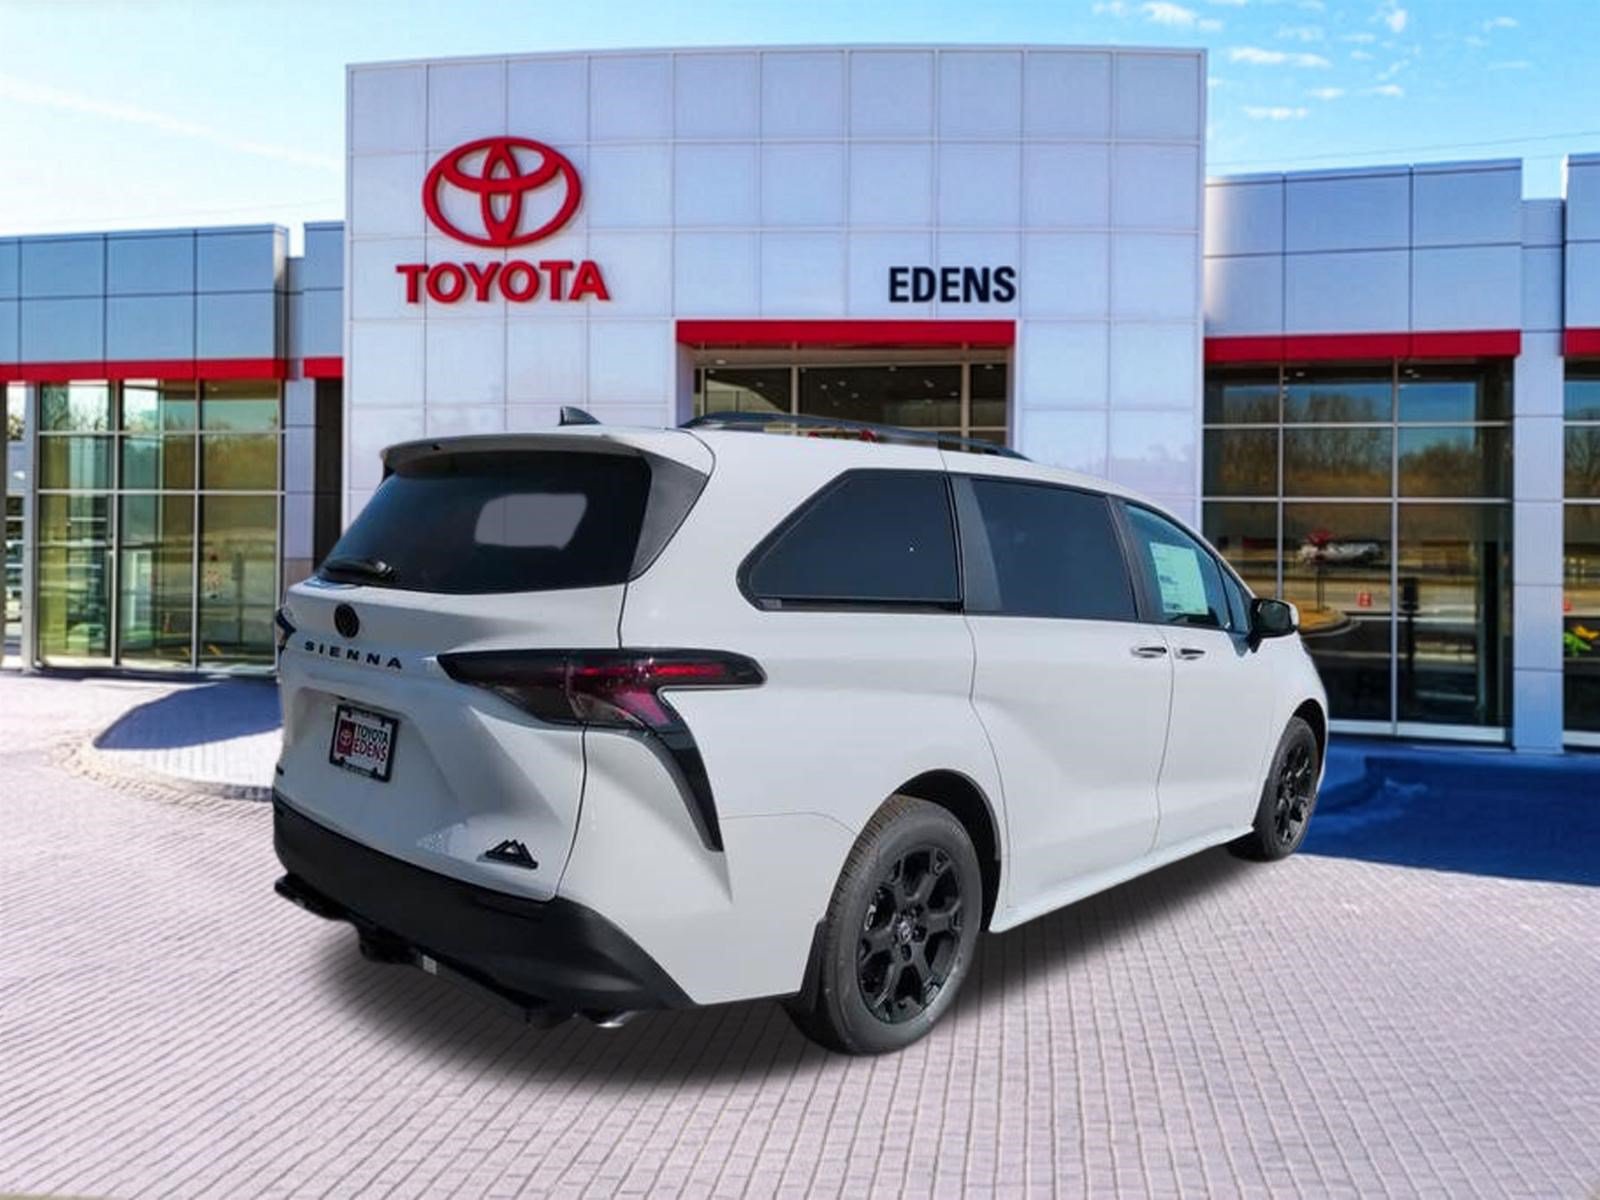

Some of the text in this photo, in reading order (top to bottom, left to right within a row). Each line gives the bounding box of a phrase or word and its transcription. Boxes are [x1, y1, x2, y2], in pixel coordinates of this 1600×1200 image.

[397, 260, 610, 304] TOYOTA
[889, 266, 1016, 303] EDENS
[304, 640, 403, 669] SIENNA
[355, 723, 388, 745] TOYOTA
[353, 738, 387, 762] EDENS
